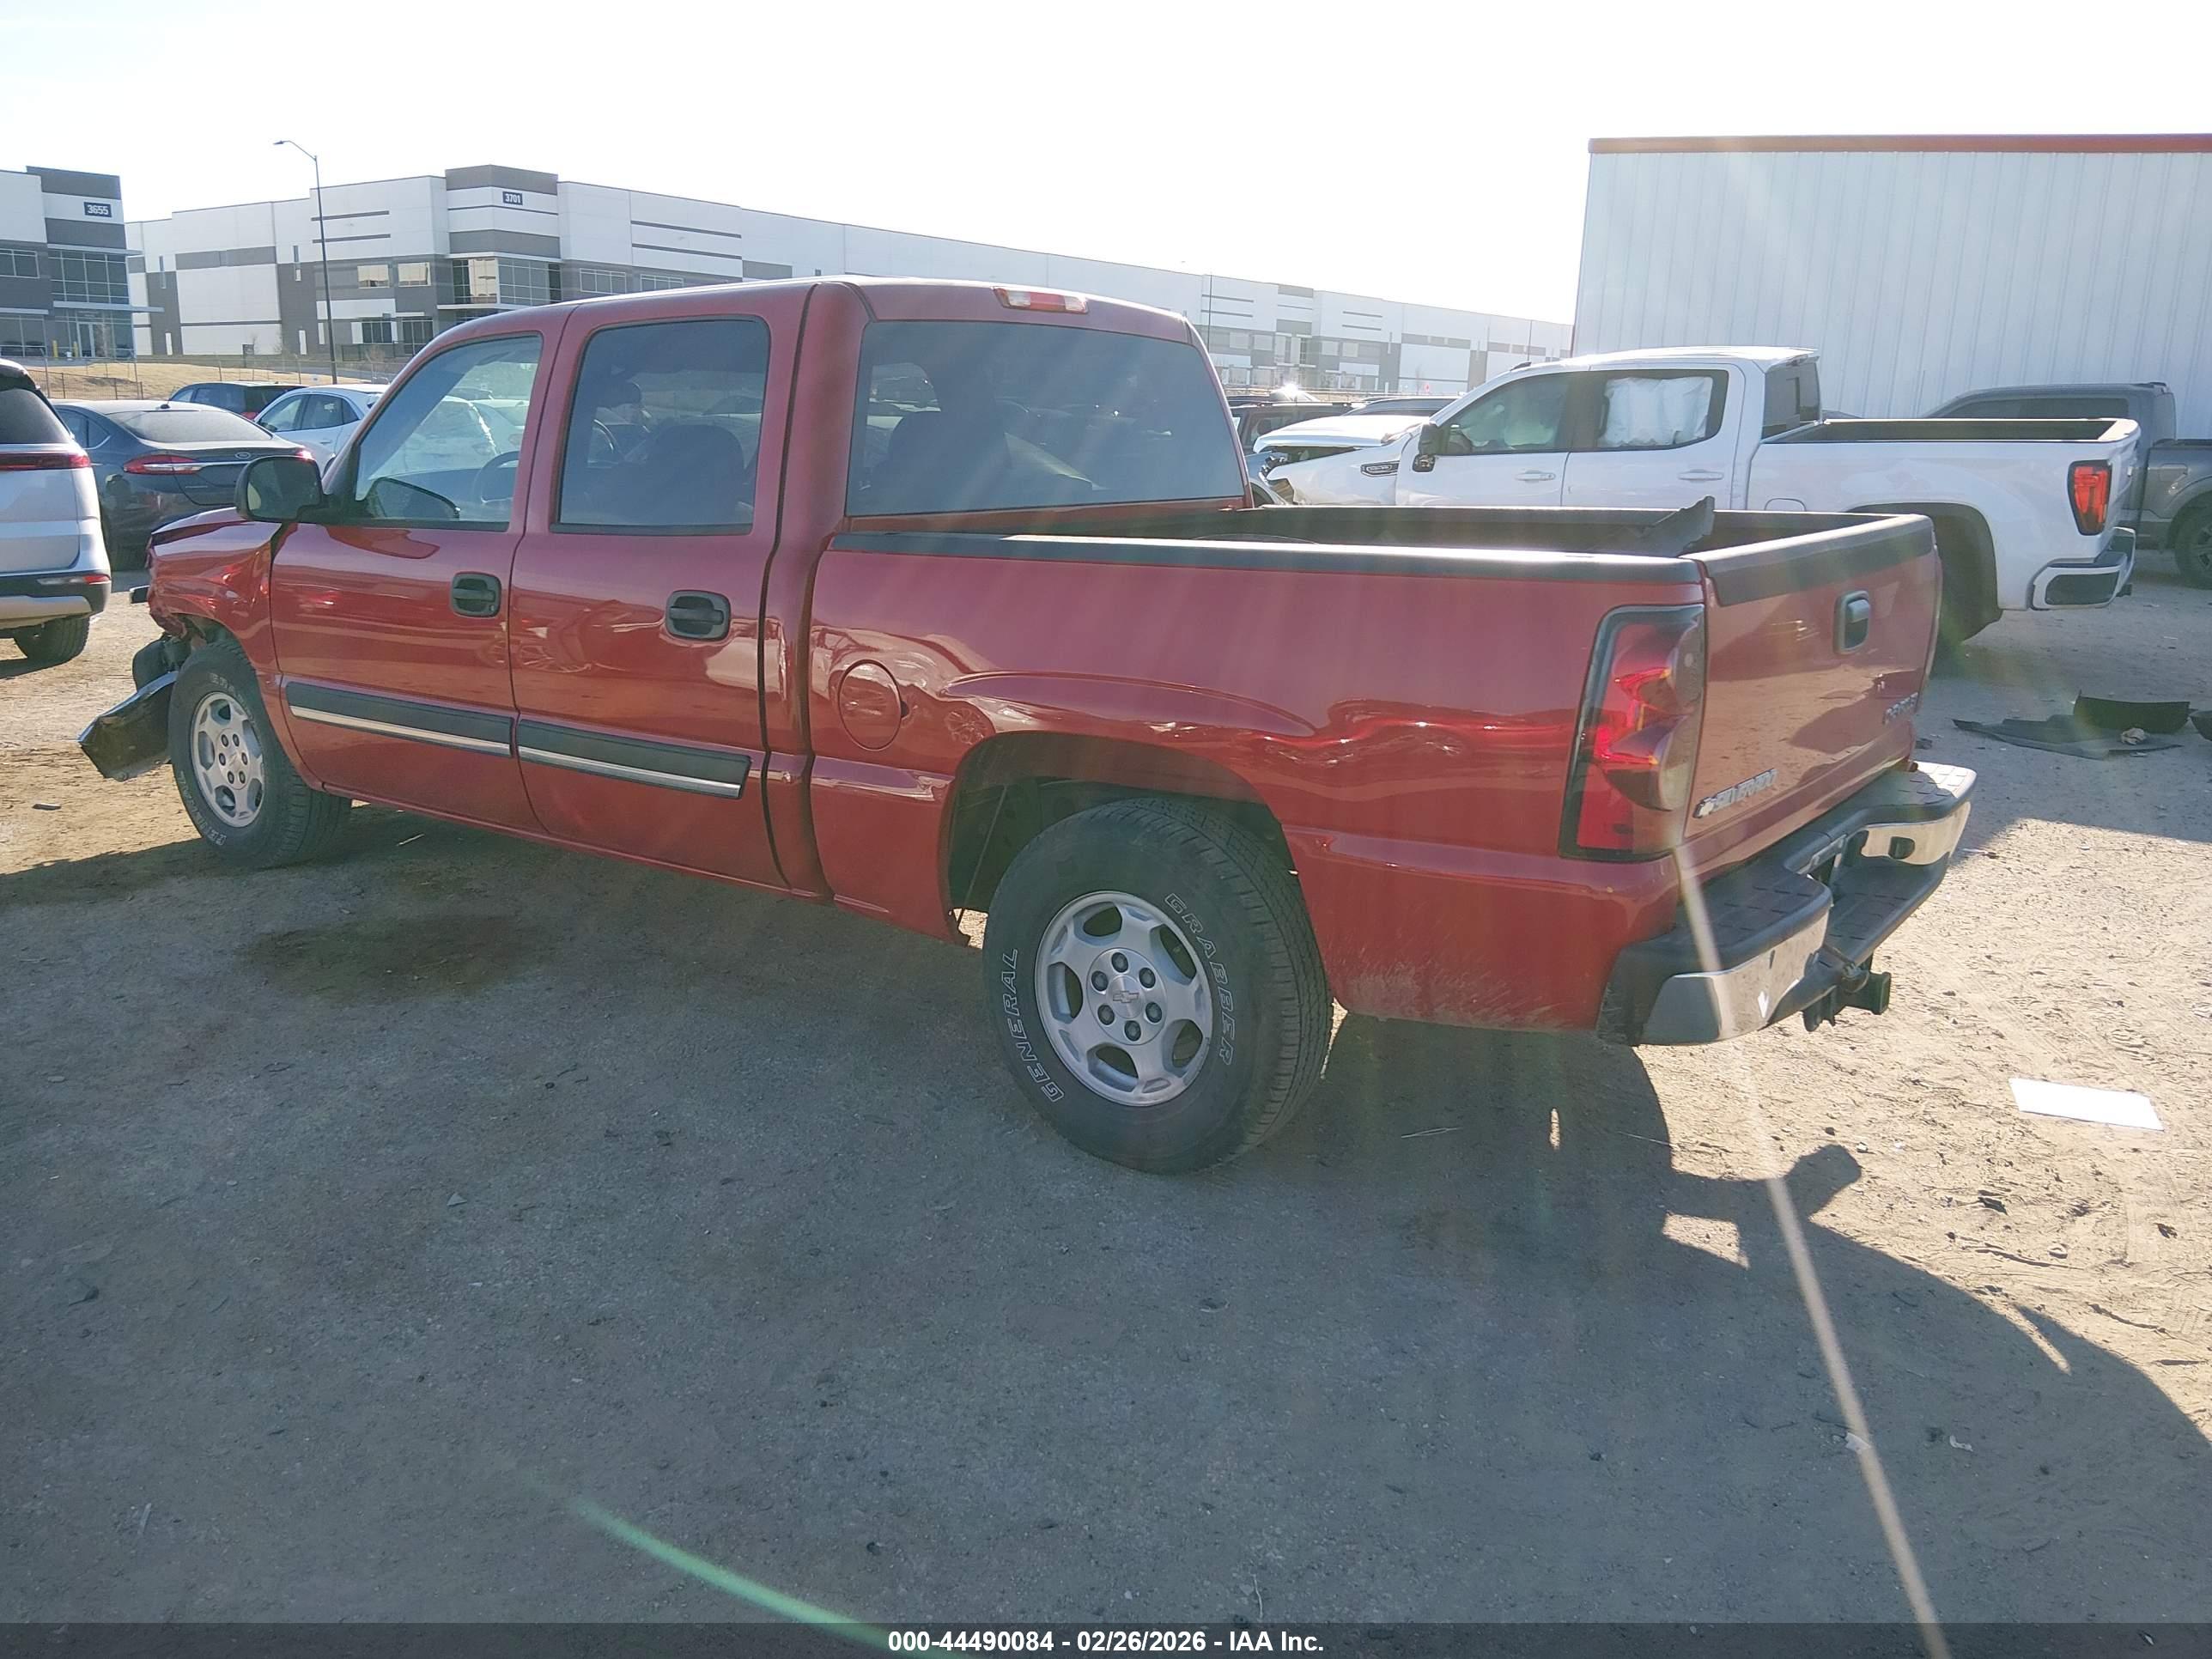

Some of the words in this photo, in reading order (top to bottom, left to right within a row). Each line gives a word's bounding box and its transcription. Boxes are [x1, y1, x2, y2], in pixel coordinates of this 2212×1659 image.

[88, 204, 109, 215] 3655
[505, 193, 521, 204] 3701
[1164, 893, 1236, 1066] GRABBER
[1000, 948, 1065, 1103] GENERAL
